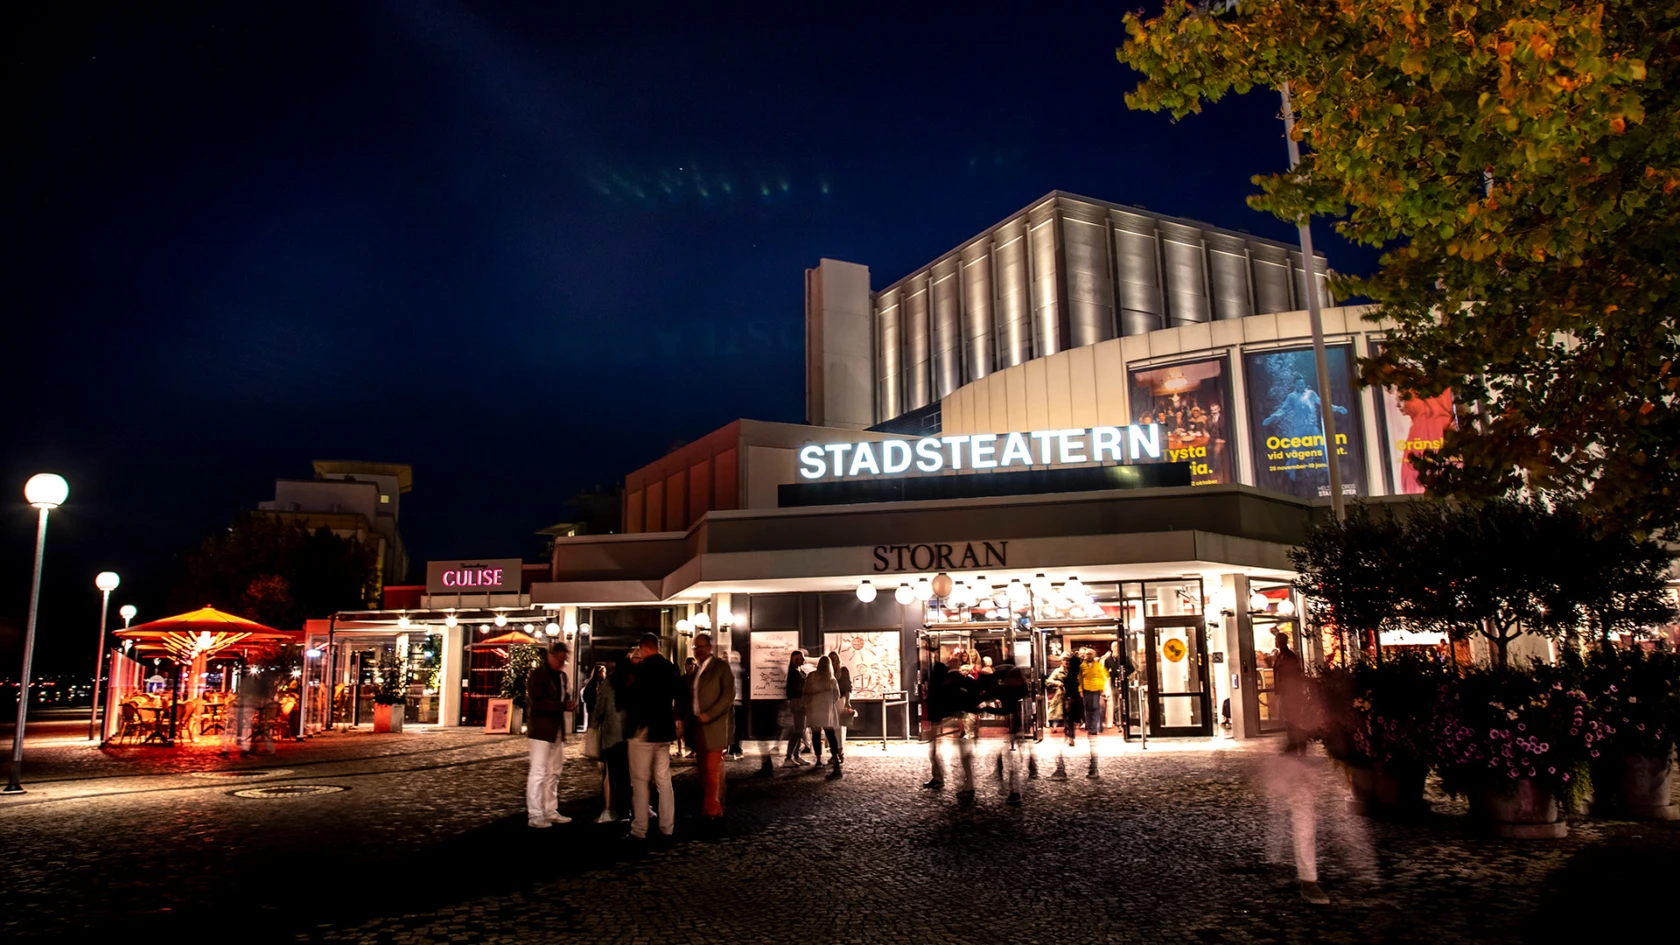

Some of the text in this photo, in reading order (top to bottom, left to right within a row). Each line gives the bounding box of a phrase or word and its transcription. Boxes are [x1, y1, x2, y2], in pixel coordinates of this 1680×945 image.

[1266, 433, 1347, 450] Oceann
[799, 423, 1161, 479] STADSTEATERN
[1161, 446, 1206, 463] Tysta
[1267, 451, 1283, 460] vid
[1285, 449, 1323, 460] vägens
[873, 541, 1008, 572] STORAN
[442, 569, 503, 587] CULISE
